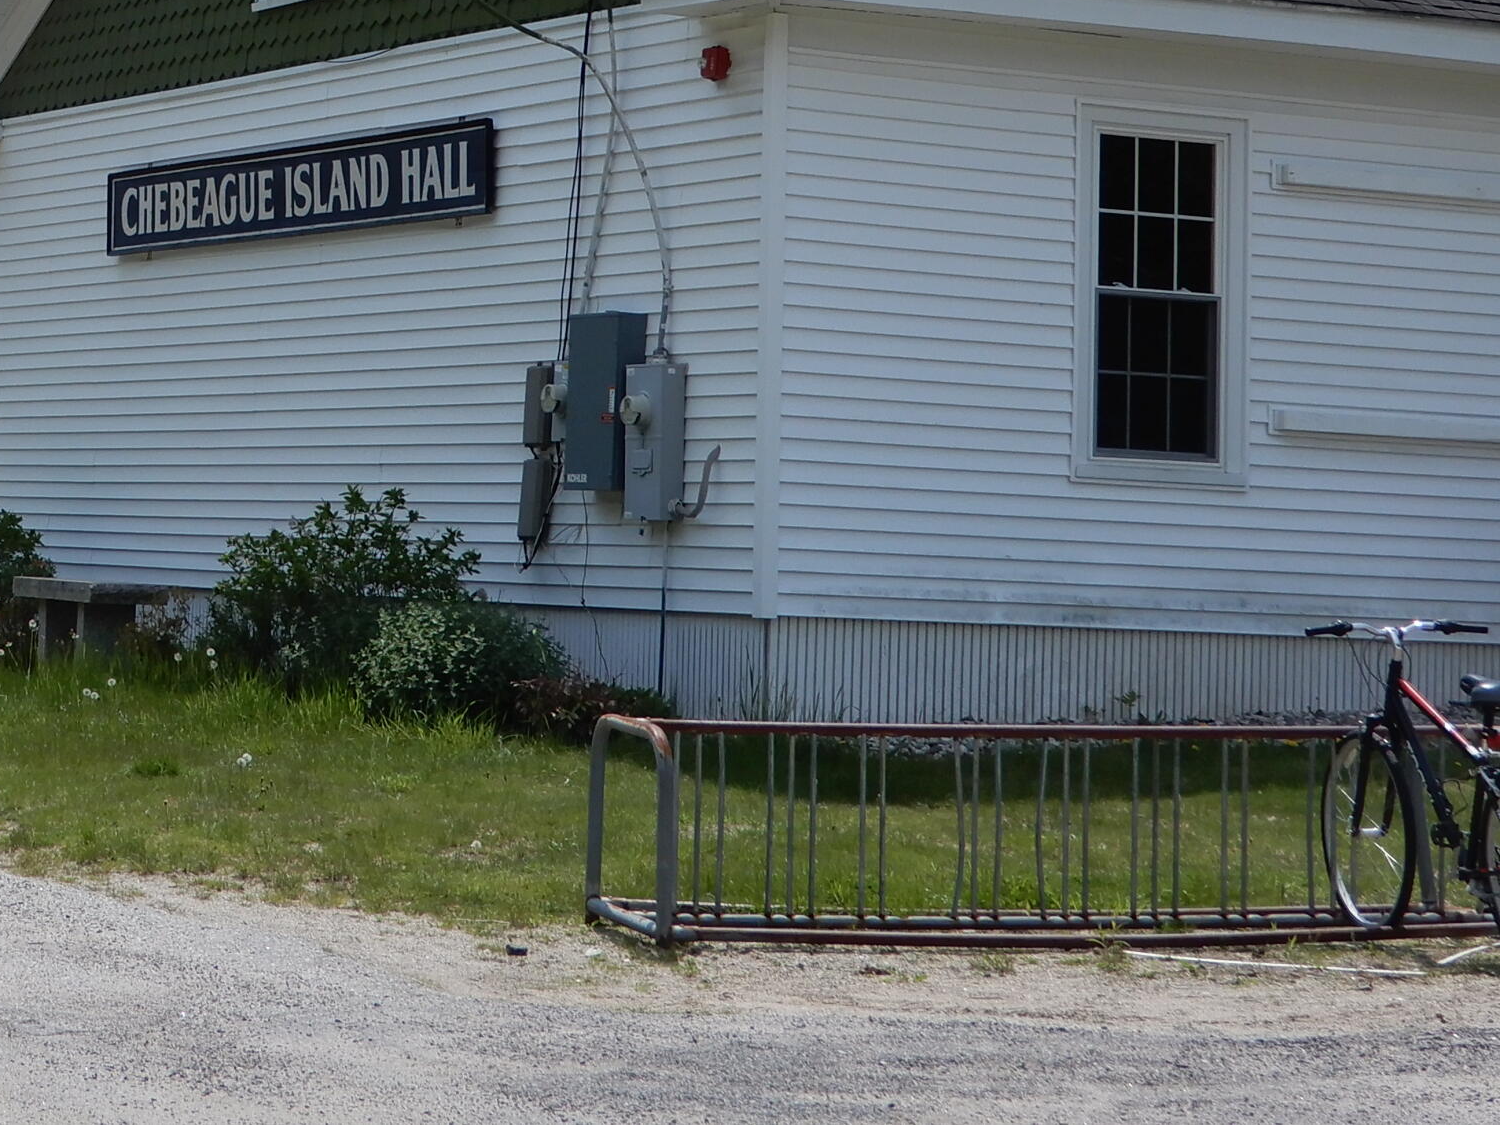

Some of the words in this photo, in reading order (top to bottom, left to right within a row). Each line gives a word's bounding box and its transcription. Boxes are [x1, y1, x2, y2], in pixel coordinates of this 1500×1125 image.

[121, 169, 275, 236] CHEBEAGUE
[284, 154, 389, 218] ISLAND
[400, 140, 475, 203] HALL
